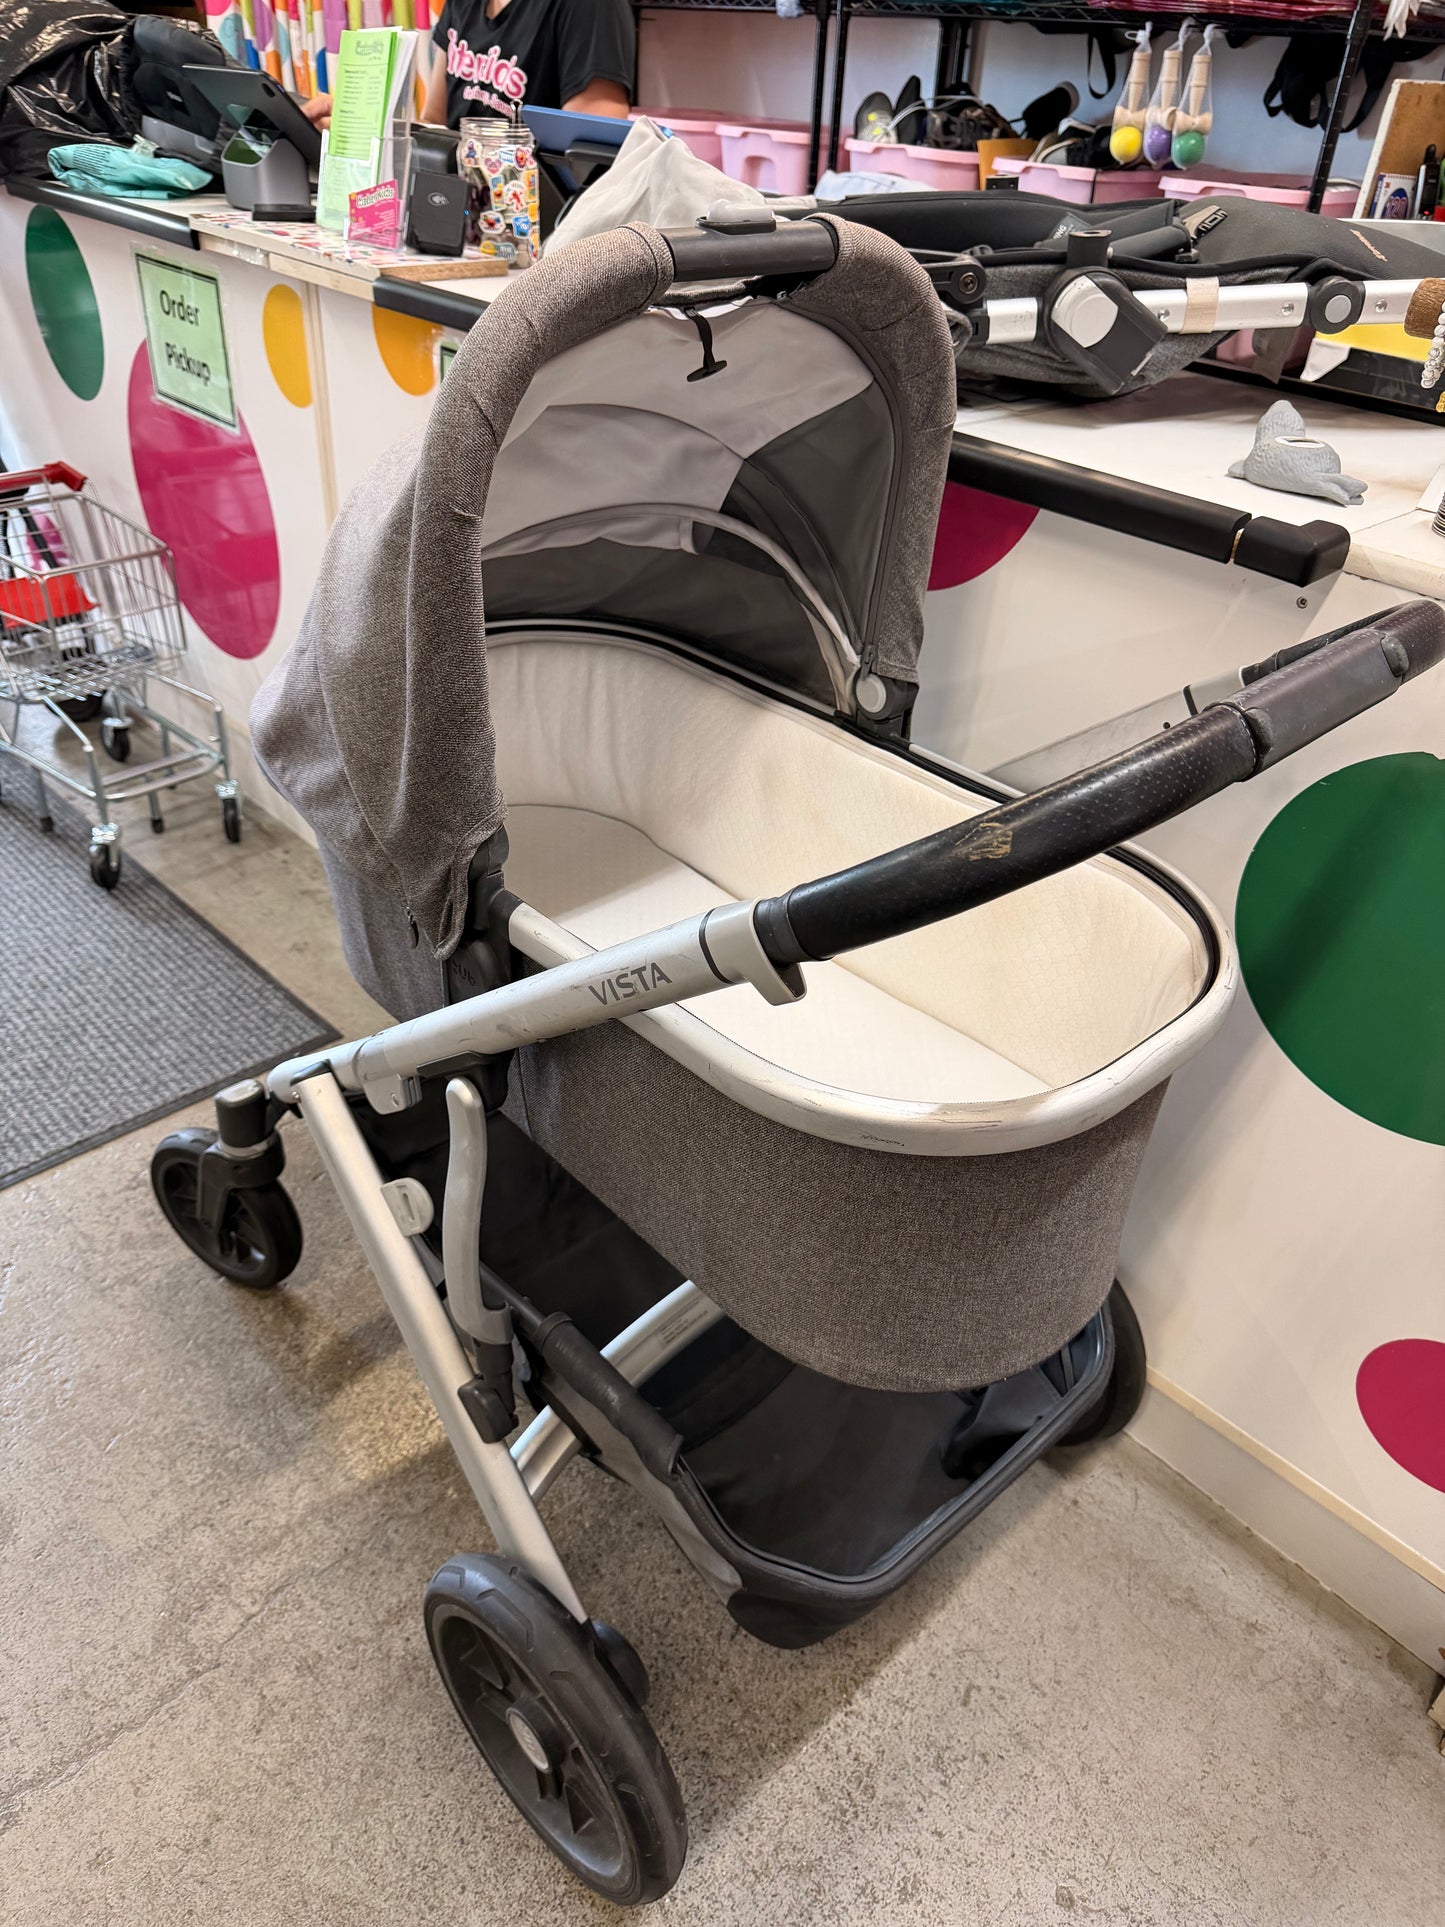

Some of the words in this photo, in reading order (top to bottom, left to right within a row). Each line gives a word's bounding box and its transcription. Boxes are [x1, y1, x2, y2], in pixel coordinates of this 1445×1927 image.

[160, 290, 200, 327] Order
[165, 342, 212, 387] Pickup
[588, 962, 673, 1006] VISTA
